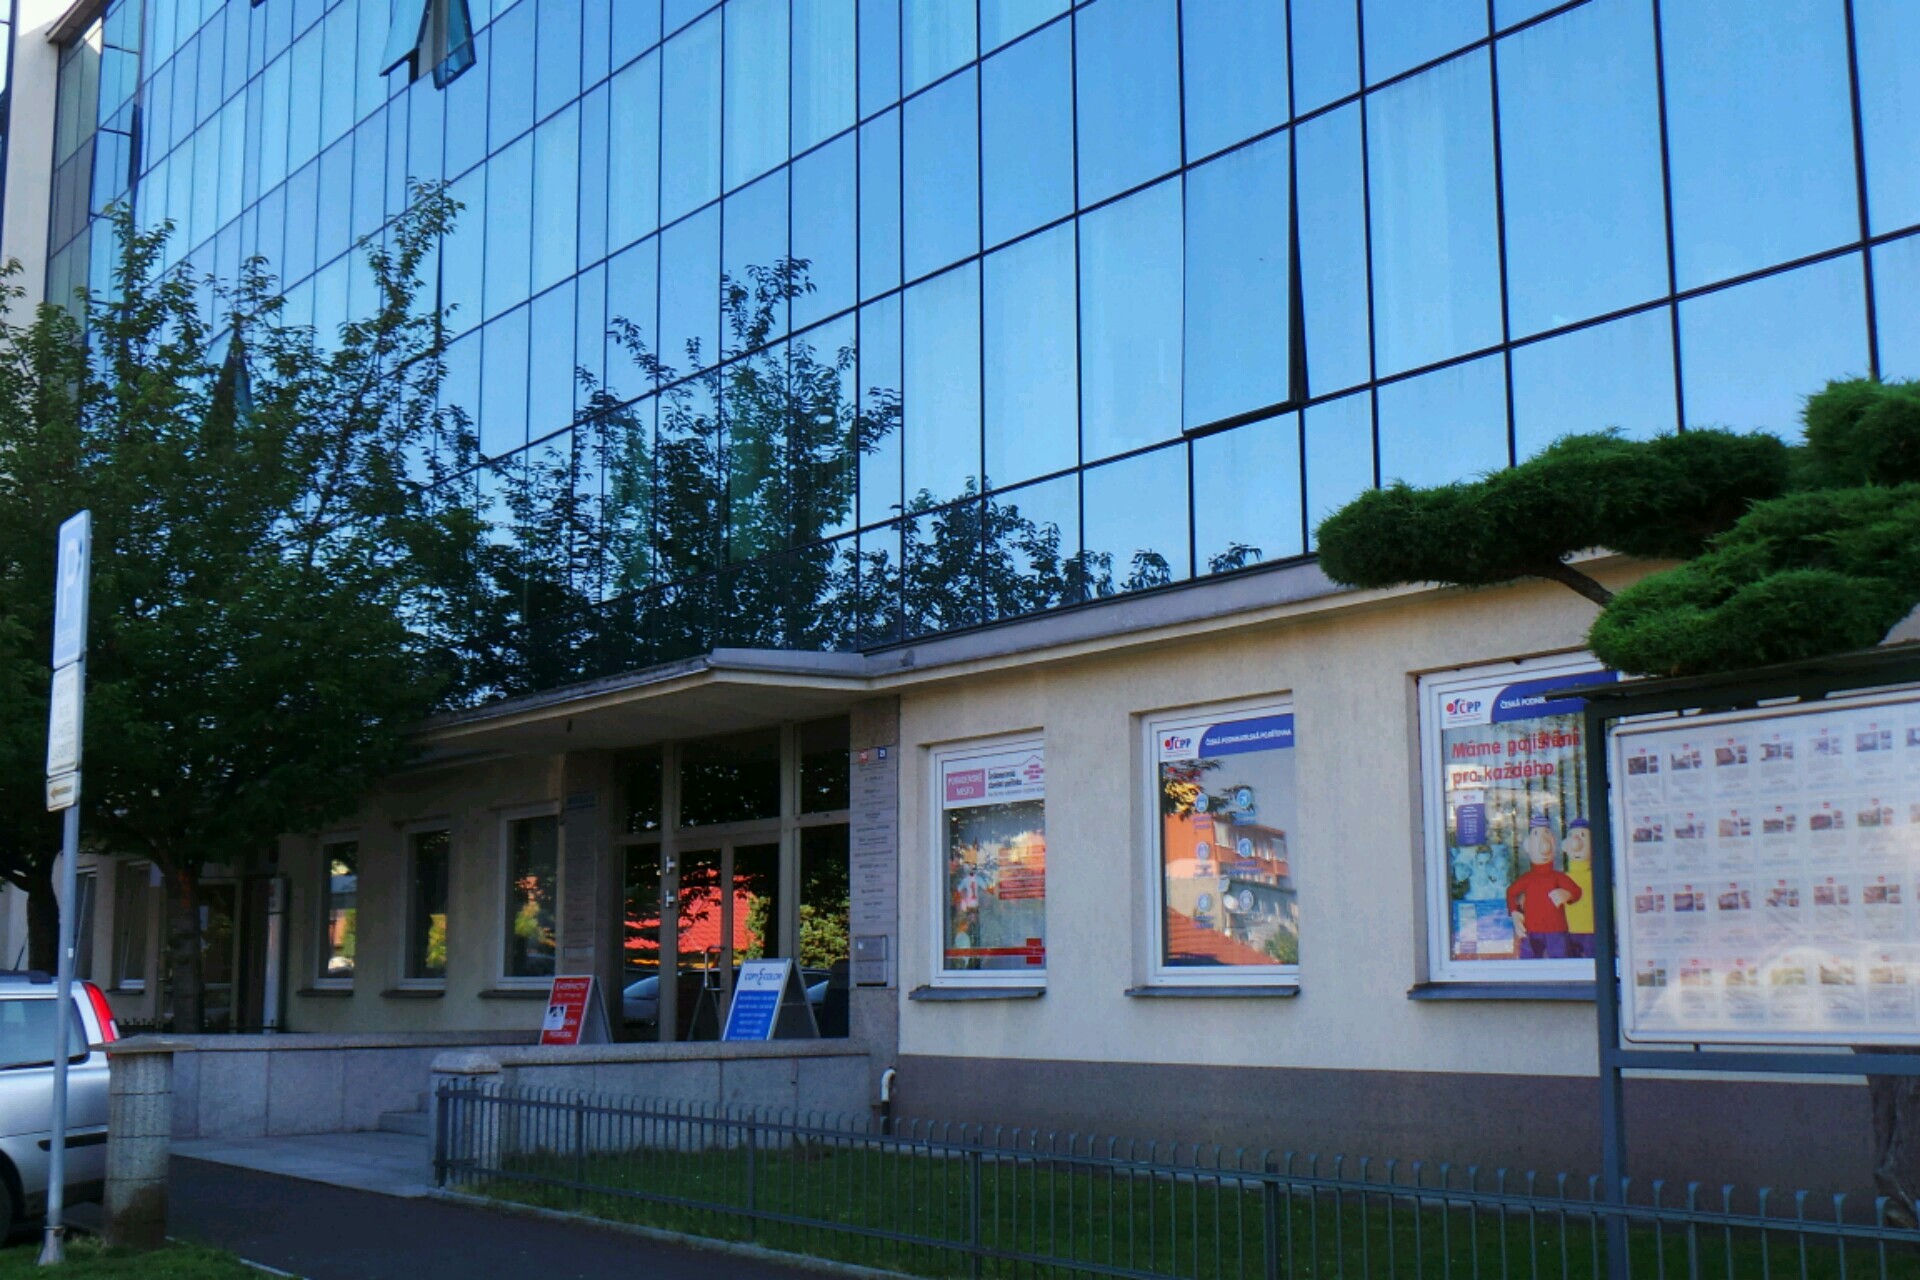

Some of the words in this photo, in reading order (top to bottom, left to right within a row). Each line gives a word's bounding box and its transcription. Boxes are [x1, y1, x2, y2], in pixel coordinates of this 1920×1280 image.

[63, 538, 79, 619] P
[1459, 700, 1481, 714] ČPP
[1174, 736, 1192, 749] ČPP
[1452, 740, 1501, 758] Máme
[1508, 727, 1580, 757] pojištění
[1453, 771, 1478, 786] pro
[1485, 760, 1554, 781] každého
